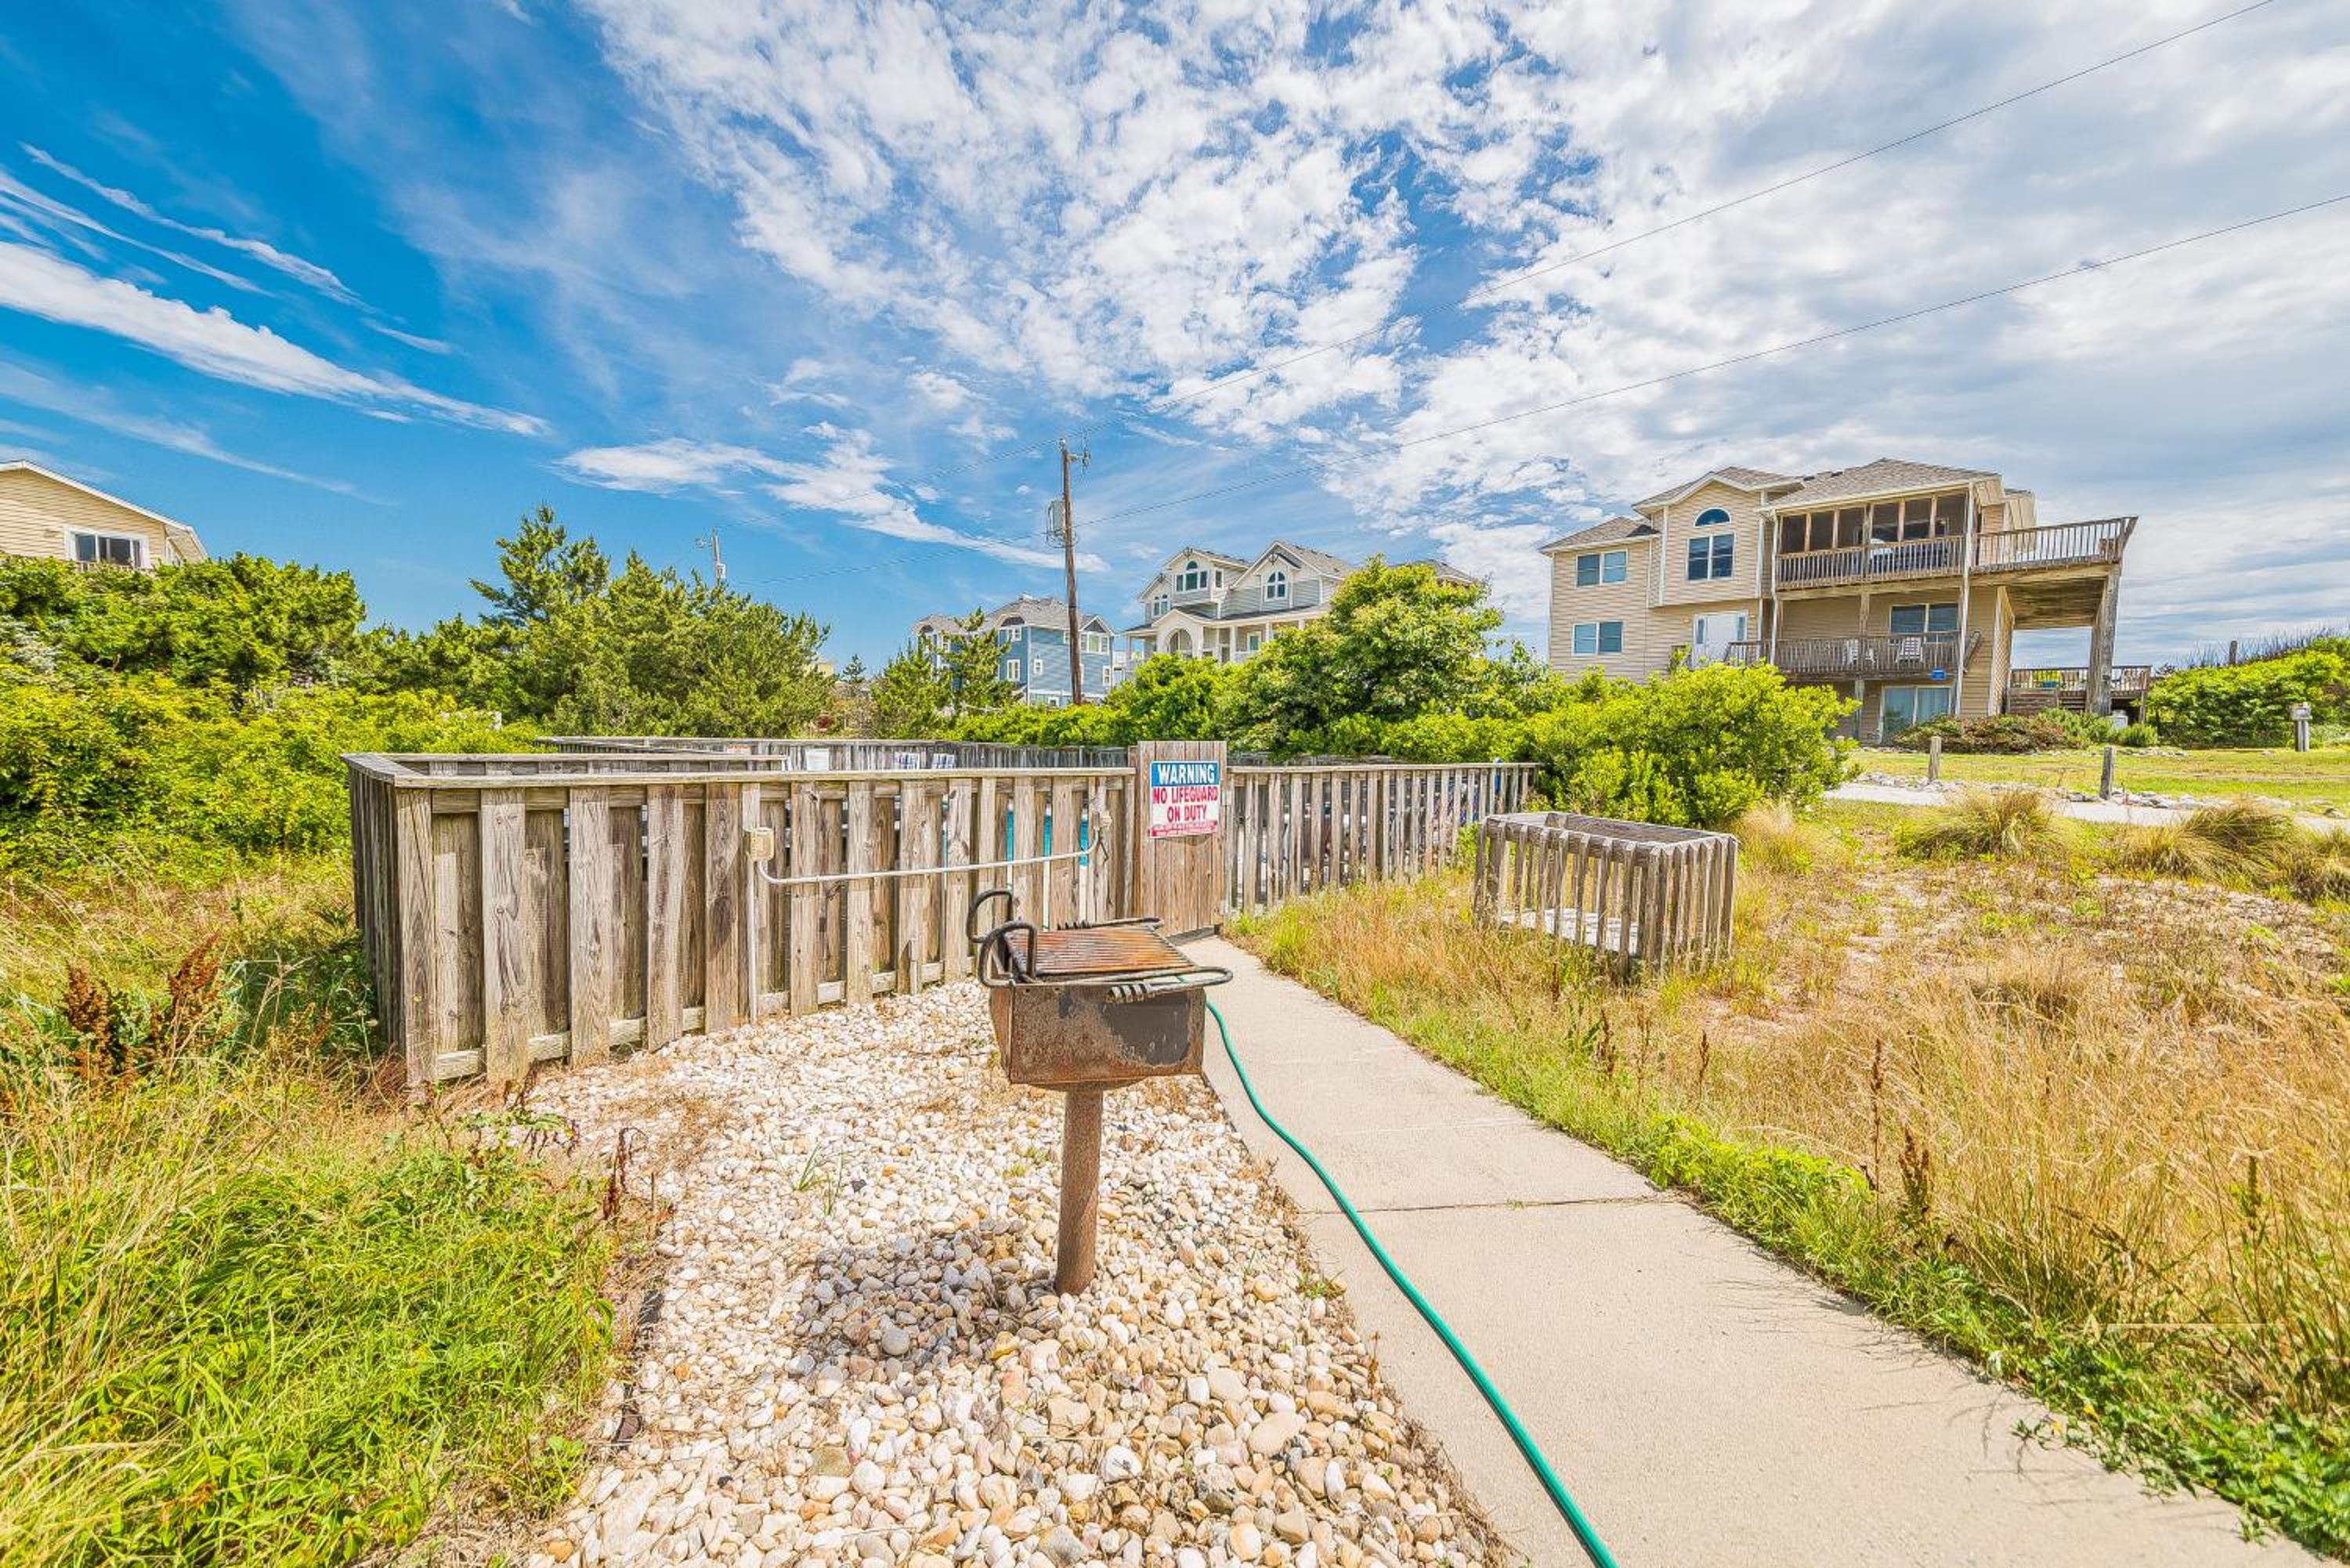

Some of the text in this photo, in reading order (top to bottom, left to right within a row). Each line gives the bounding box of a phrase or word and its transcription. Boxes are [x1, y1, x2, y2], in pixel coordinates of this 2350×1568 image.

[1158, 764, 1215, 785] WARNING
[1152, 786, 1218, 804] NO LIFEGUARD
[1166, 804, 1207, 822] ON DUTY
